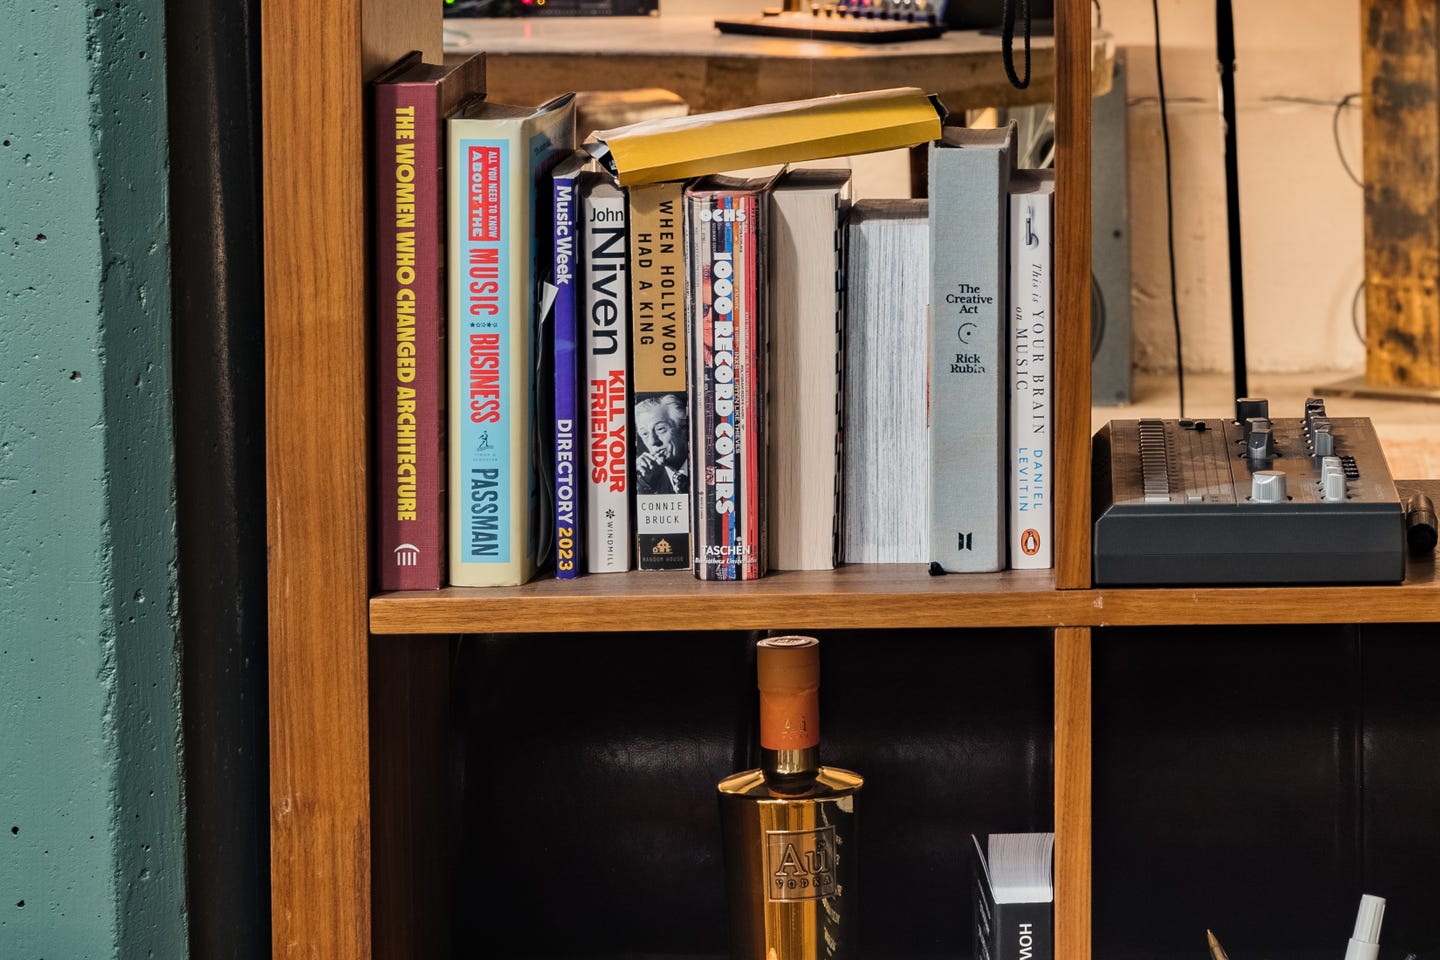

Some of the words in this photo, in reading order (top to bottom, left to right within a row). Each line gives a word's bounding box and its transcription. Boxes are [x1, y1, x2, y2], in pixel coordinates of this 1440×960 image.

[395, 106, 415, 139] THE
[472, 150, 483, 204] ABOUT
[488, 151, 497, 163] ALL
[488, 166, 497, 181] YOU
[396, 143, 416, 228] WOMEN
[488, 182, 498, 202] NEED
[472, 207, 483, 238] THE
[488, 204, 497, 214] TO
[488, 218, 497, 238] KNOW
[556, 185, 573, 236] Music
[589, 207, 624, 222] John
[659, 200, 674, 253] WHEN
[700, 208, 746, 222] OCHS
[396, 231, 416, 285] WHO
[556, 237, 573, 285] Week
[638, 233, 653, 268] HAD
[469, 248, 499, 316] MUSIC
[592, 227, 625, 355] Niven
[639, 280, 653, 290] A
[713, 252, 733, 315] 1000
[958, 283, 980, 294] The
[1032, 263, 1042, 288] This
[1032, 292, 1039, 303] is
[660, 266, 677, 376] HOLLYWOOD
[946, 294, 993, 304] Creative
[959, 304, 979, 314] Act
[1015, 306, 1023, 321] on
[396, 288, 416, 383] CHANGED
[640, 302, 654, 345] KING
[1032, 309, 1044, 363] YOUR
[469, 333, 500, 424] BUSINESS
[714, 321, 735, 417] RECORD
[950, 363, 986, 374] Rubin
[955, 353, 981, 364] Rick
[1015, 328, 1028, 390] MUSIC
[608, 370, 625, 422] KILL
[1032, 375, 1045, 434] BRAIN
[396, 386, 417, 521] ARCHITECTURE
[590, 379, 608, 484] FRIENDS
[557, 419, 573, 524] DIRECTORY
[609, 424, 626, 493] YOUR
[715, 422, 735, 515] COVERS
[1018, 447, 1028, 512] LEVITIN
[1033, 450, 1043, 509] DANIEL
[471, 468, 499, 556] PASSMAN
[641, 501, 683, 511] CONNIE
[645, 515, 680, 525] BRUCK
[558, 527, 574, 571] 2023
[702, 545, 750, 556] TASCHEN
[775, 876, 832, 889] VODKA
[1019, 923, 1033, 960] HOW
